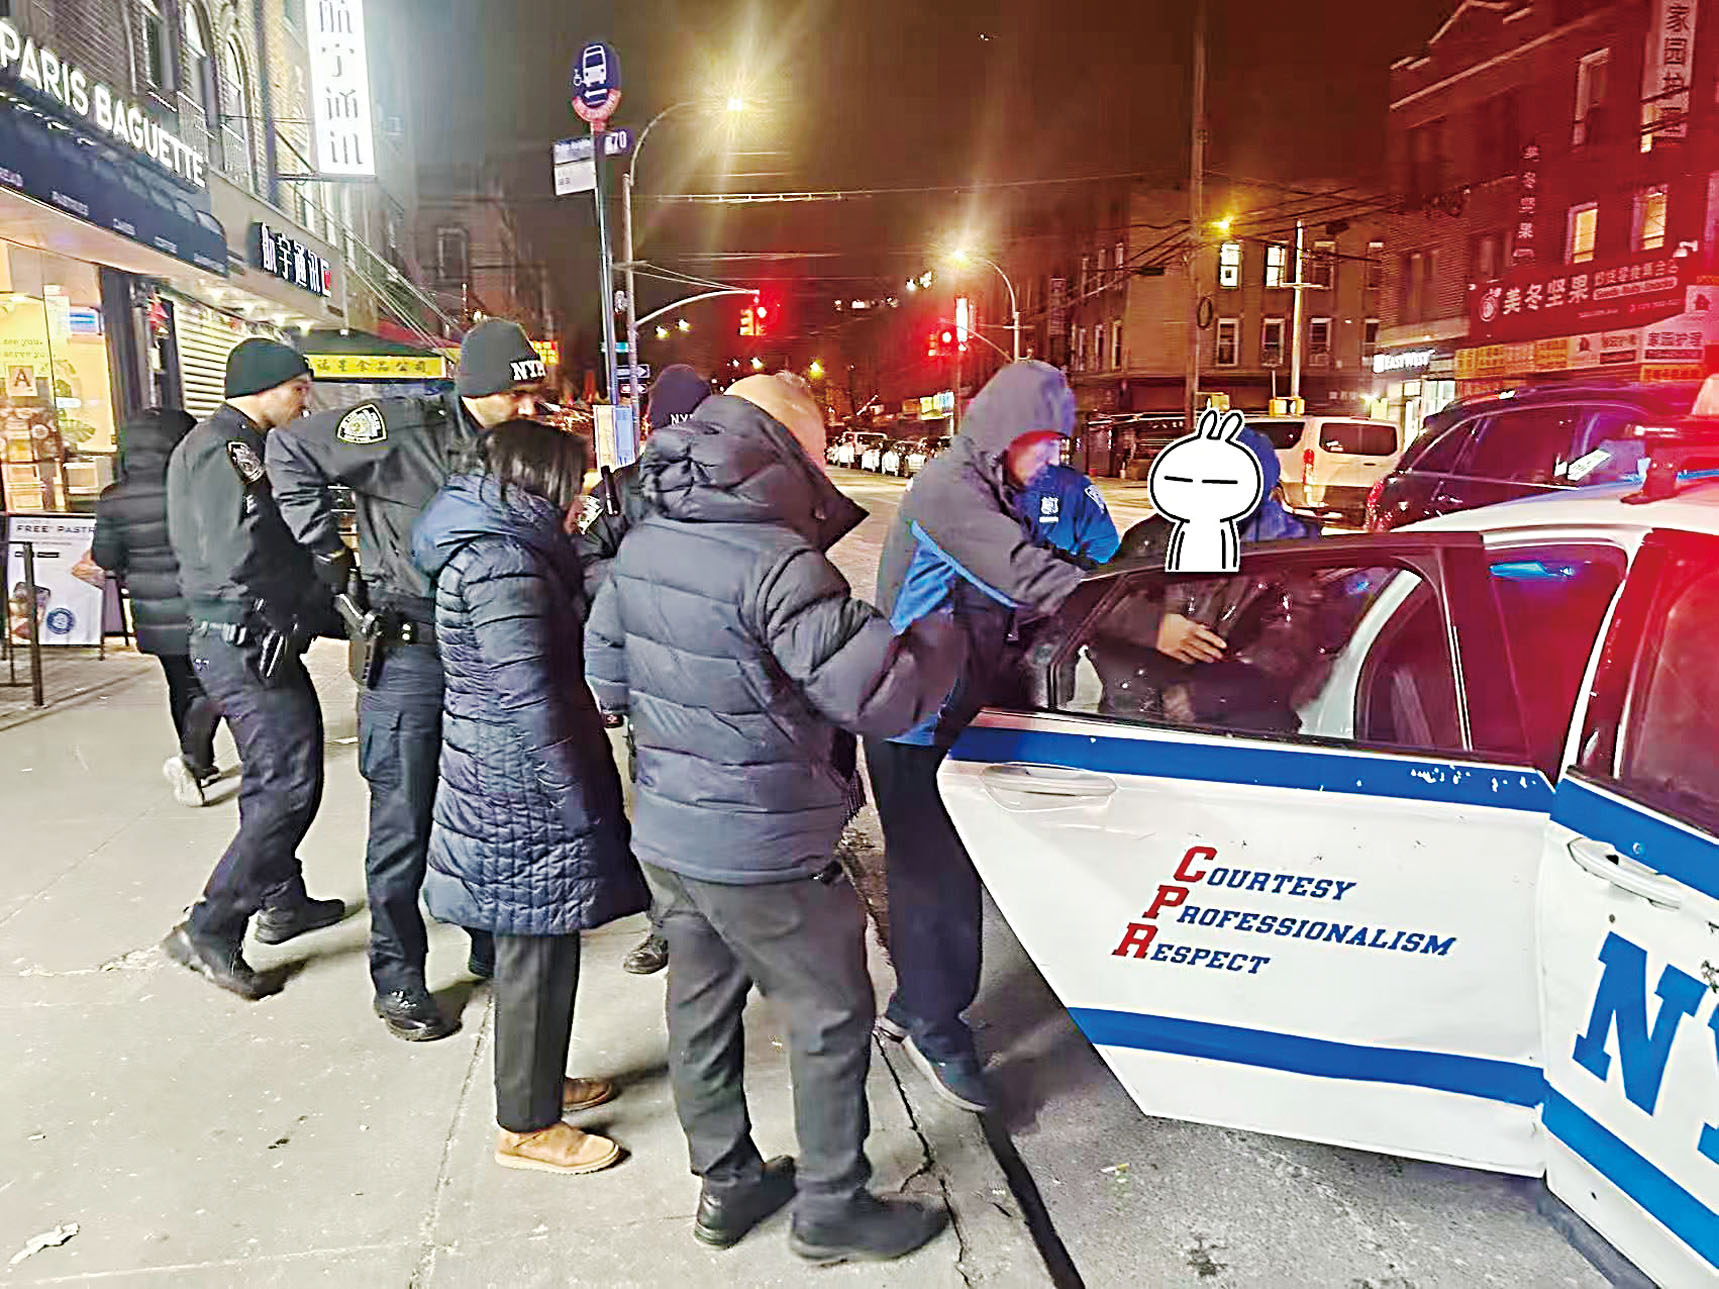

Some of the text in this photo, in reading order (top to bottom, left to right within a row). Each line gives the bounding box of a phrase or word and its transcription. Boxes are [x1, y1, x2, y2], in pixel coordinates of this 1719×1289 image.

[0, 18, 206, 188] PARIS BAGUETTE
[1503, 275, 1588, 315] 美冬坚果
[14, 369, 31, 387] A
[1173, 846, 1357, 900] COURTESY
[1142, 885, 1457, 956] PROFESSIONALISM
[1111, 922, 1270, 974] RESPECT
